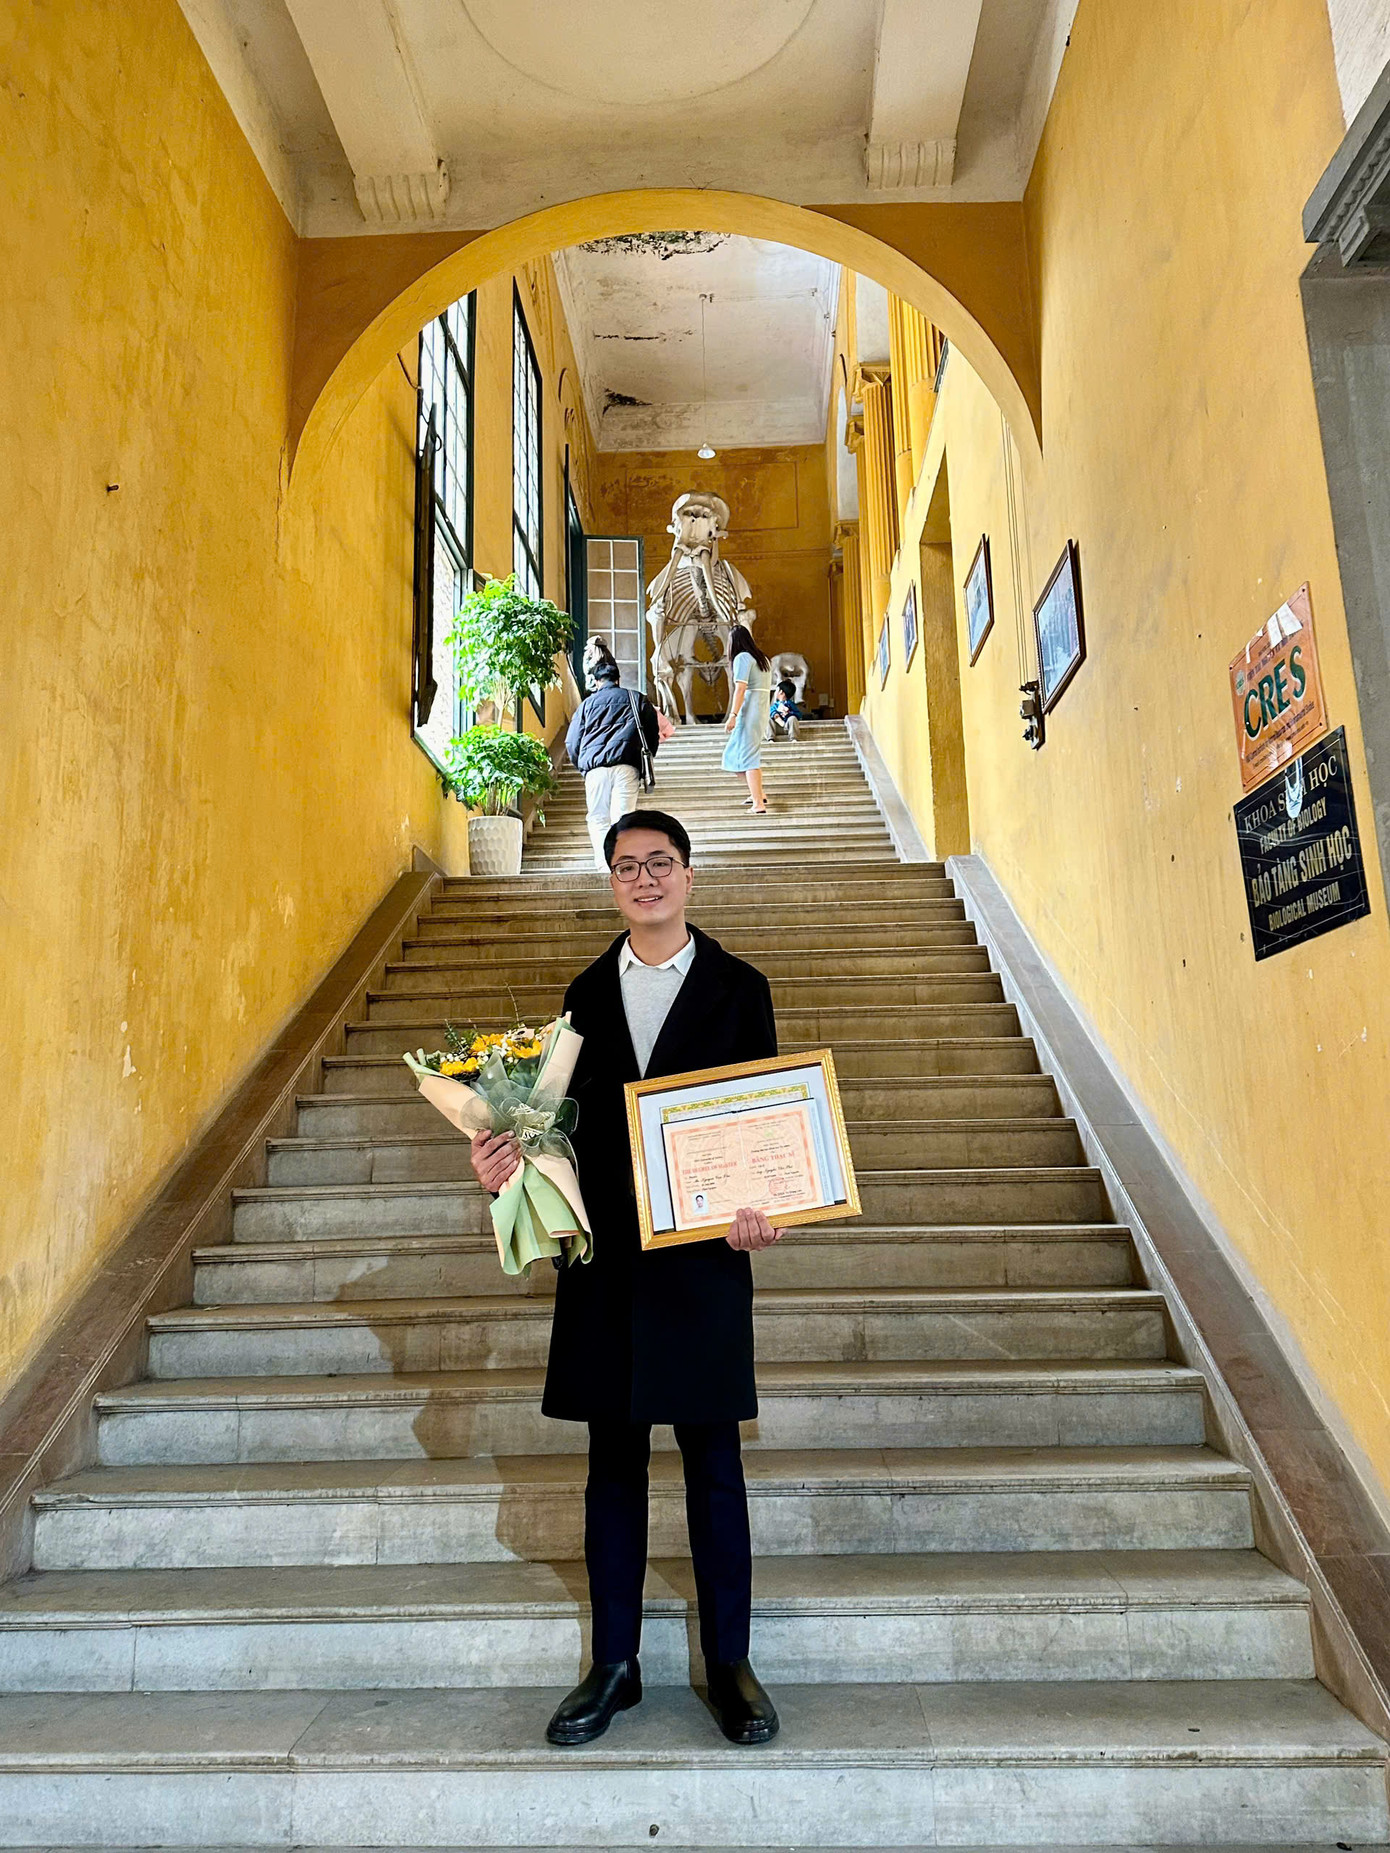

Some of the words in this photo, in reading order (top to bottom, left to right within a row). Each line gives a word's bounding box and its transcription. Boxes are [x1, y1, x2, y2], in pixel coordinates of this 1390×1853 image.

[1244, 645, 1306, 739] CRES
[1244, 800, 1278, 834] KHOA
[1308, 755, 1338, 790] HỌC
[1287, 818, 1296, 838] OF
[1297, 797, 1327, 832] BIOLOGY
[1251, 863, 1272, 908] BẢO
[1271, 856, 1299, 897] TÀNG
[1299, 839, 1327, 882] SINH
[1326, 825, 1353, 870] HỌC
[1268, 898, 1307, 932] BIOLOGICAL
[1306, 881, 1341, 915] MUSEUM
